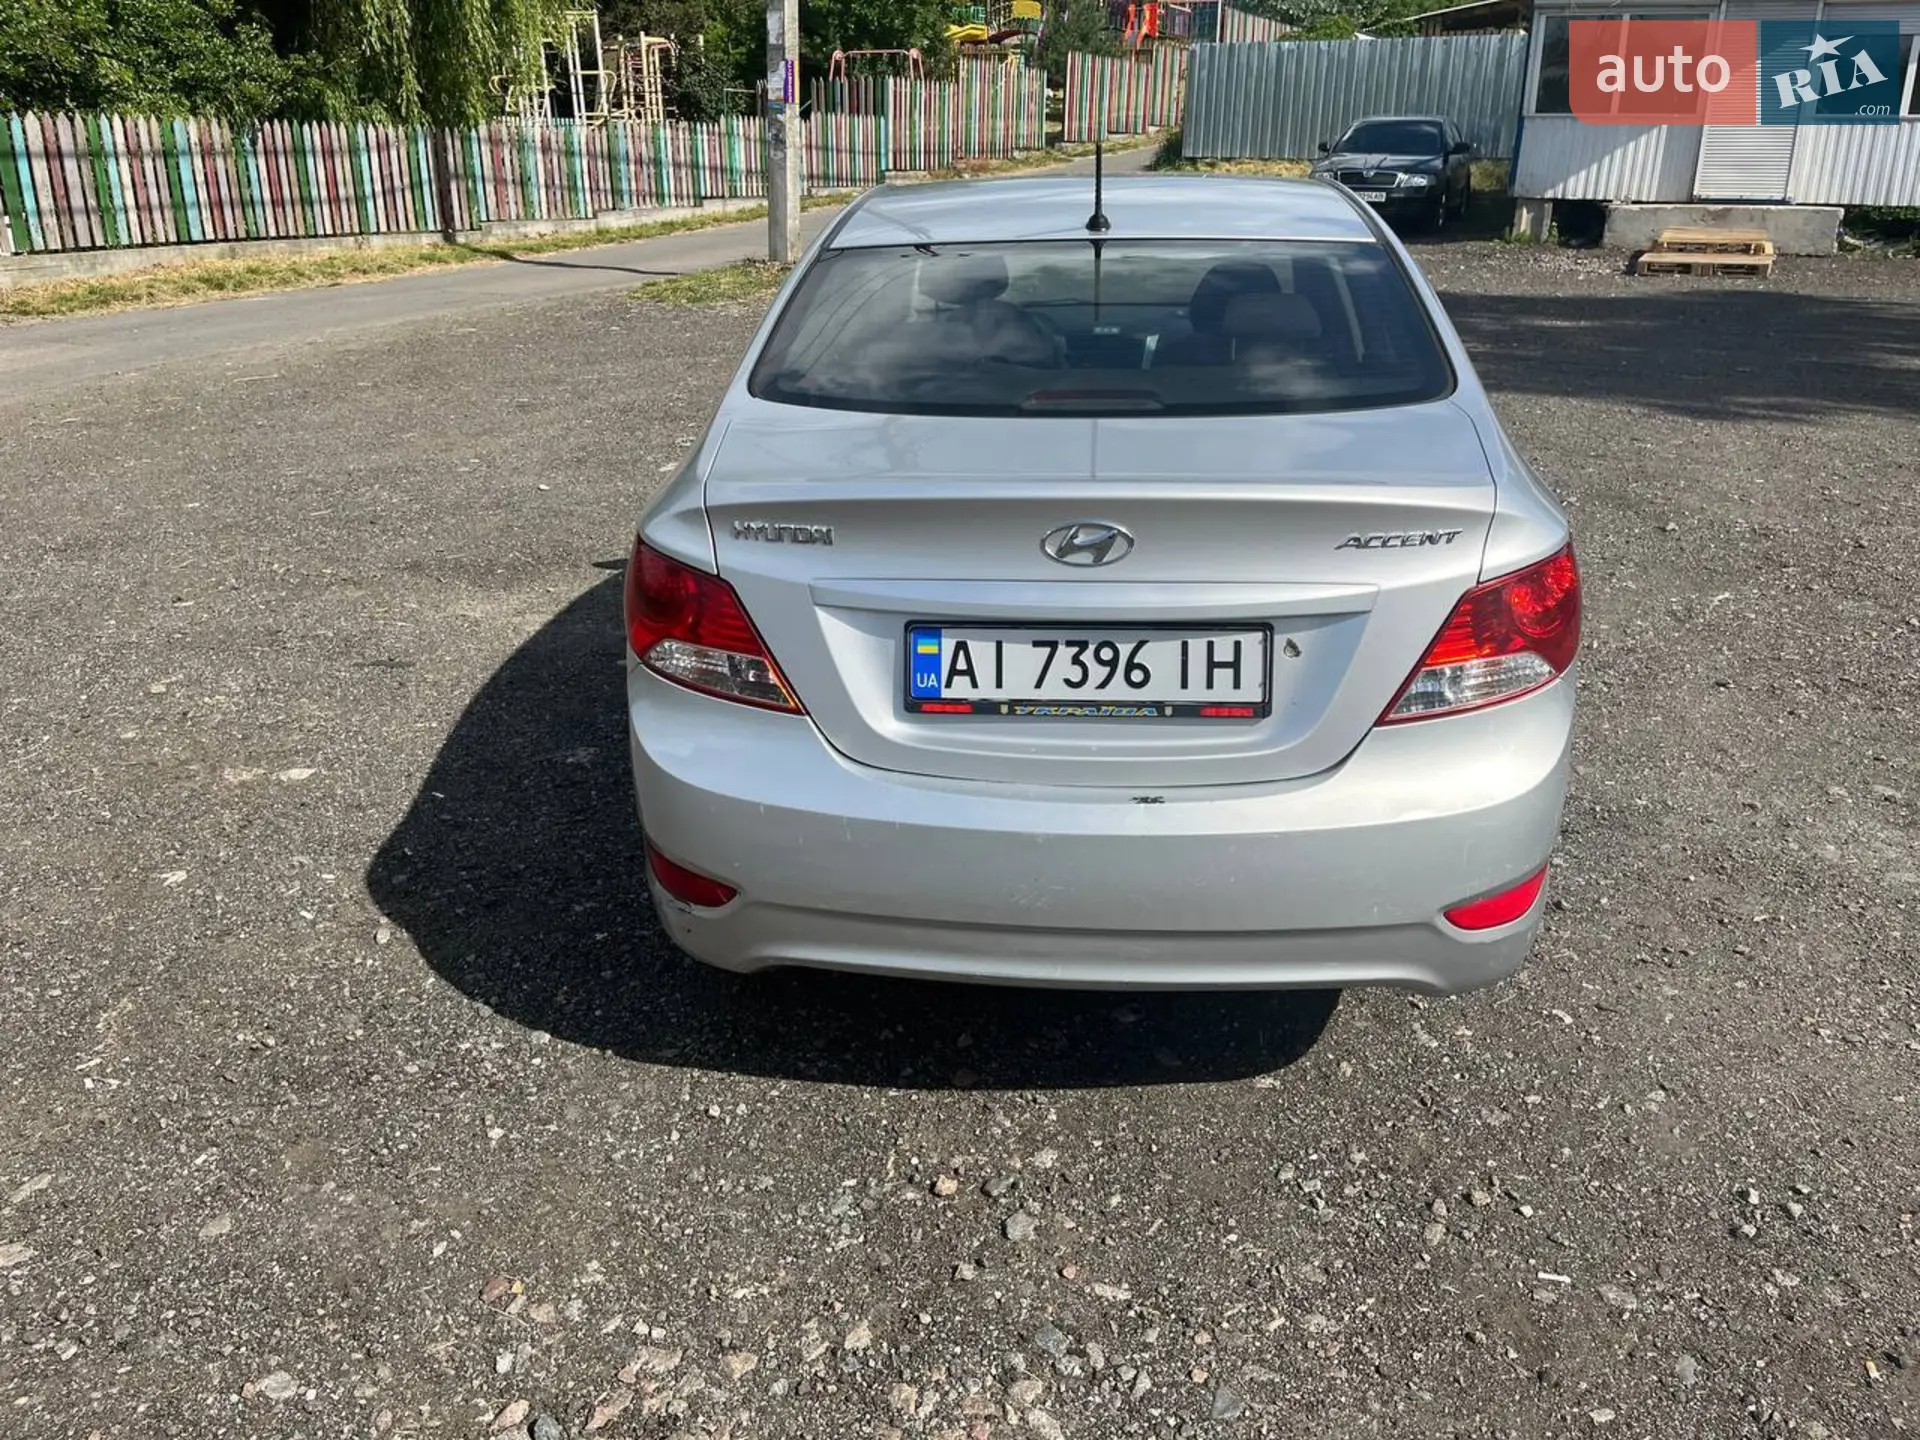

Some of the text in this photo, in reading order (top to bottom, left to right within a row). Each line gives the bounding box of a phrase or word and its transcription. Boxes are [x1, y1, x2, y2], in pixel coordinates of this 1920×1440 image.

[732, 520, 833, 545] HYUNDAI
[1334, 527, 1463, 550] ACCENT
[943, 640, 1242, 690] AI 7396 IH
[916, 672, 938, 688] UA
